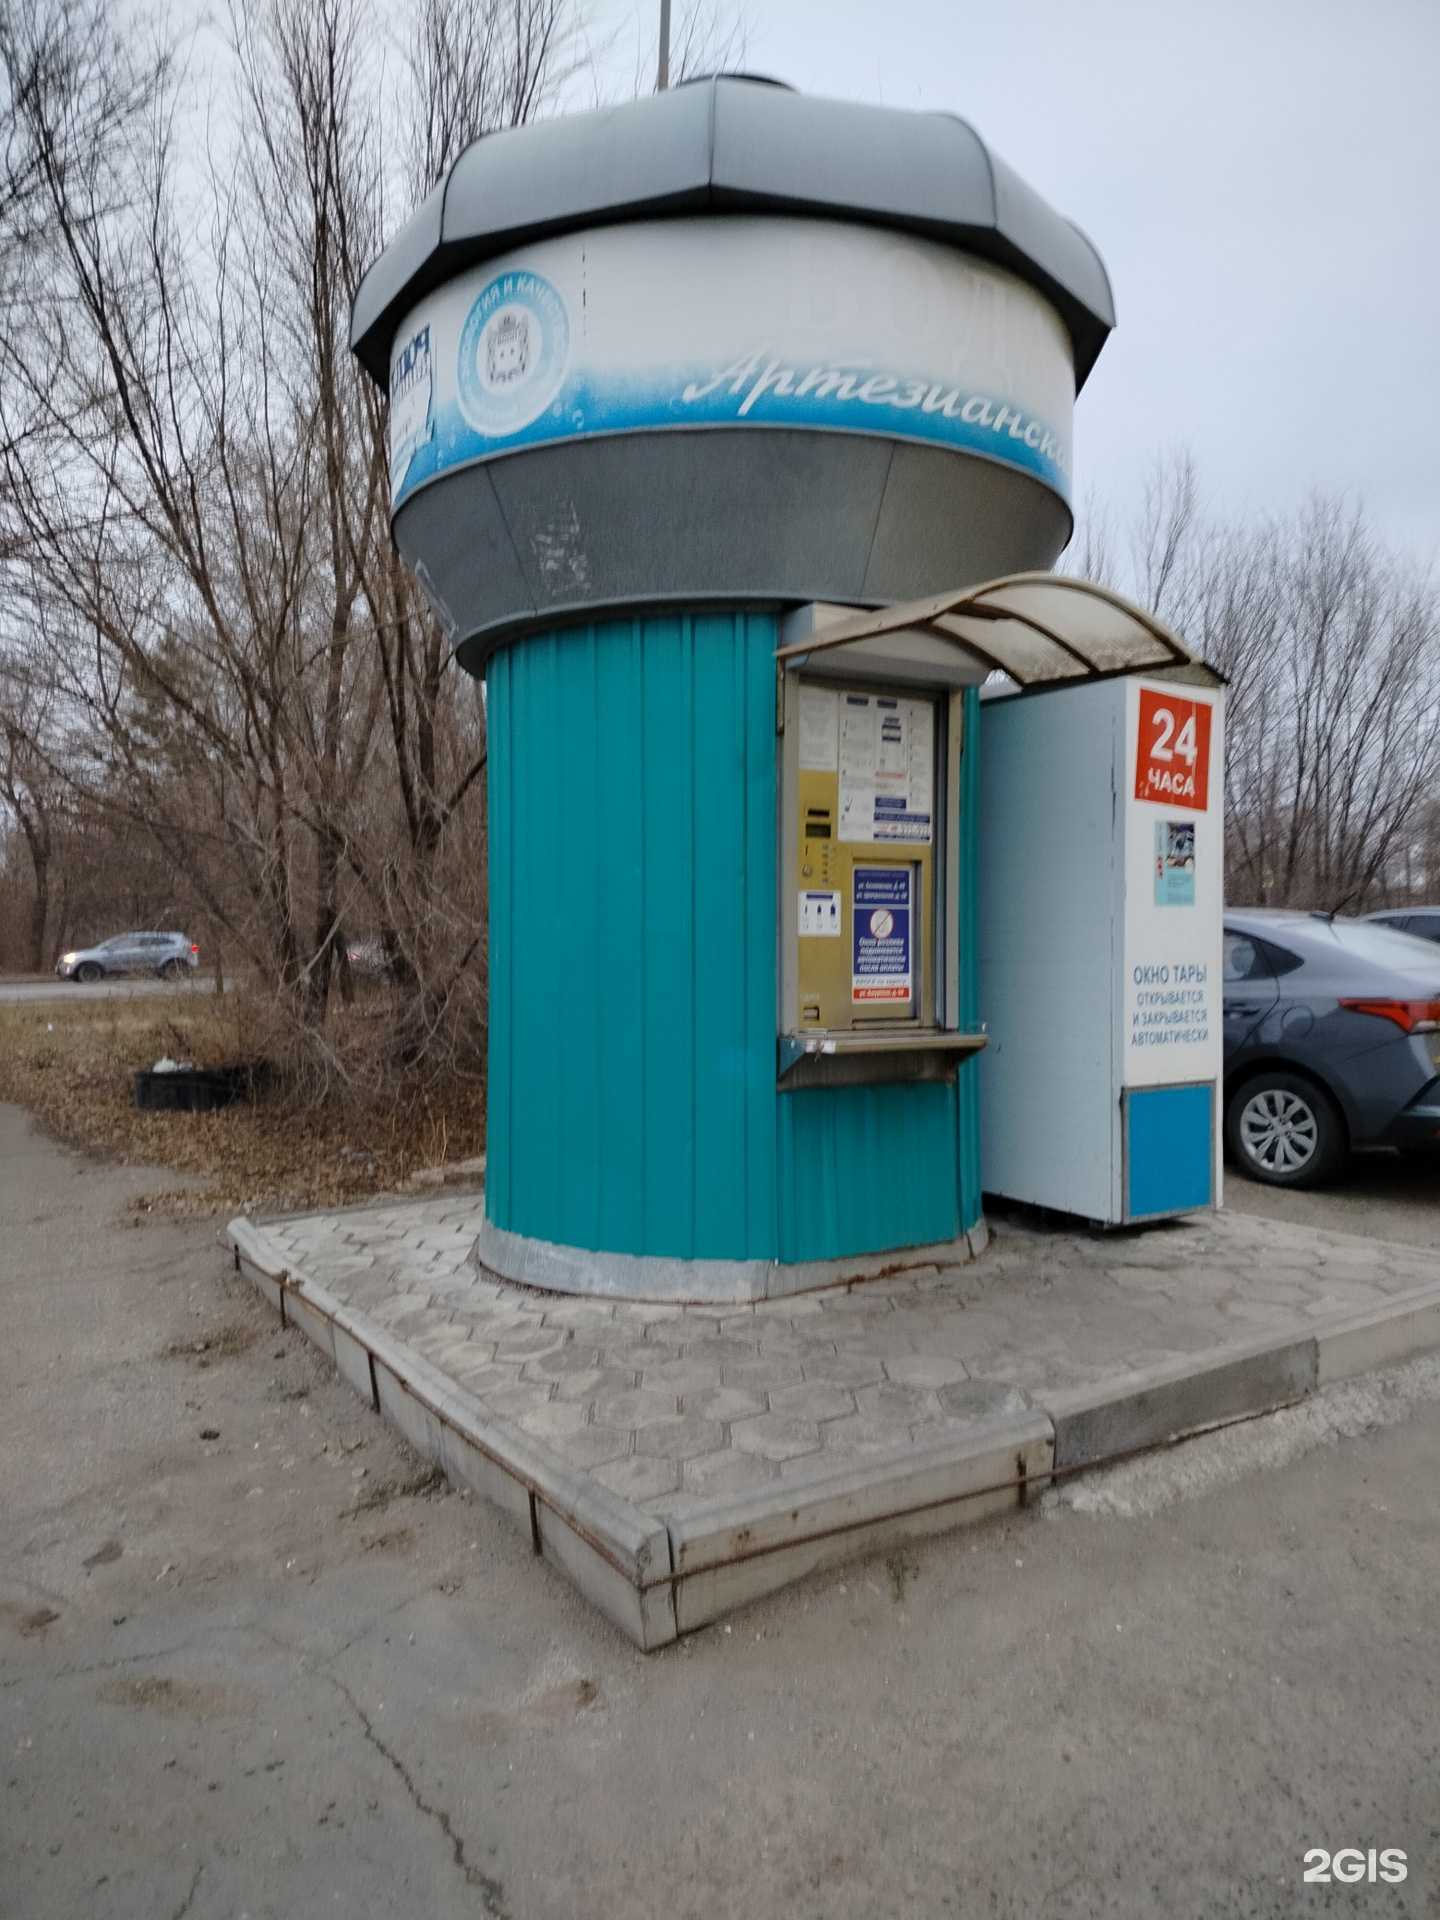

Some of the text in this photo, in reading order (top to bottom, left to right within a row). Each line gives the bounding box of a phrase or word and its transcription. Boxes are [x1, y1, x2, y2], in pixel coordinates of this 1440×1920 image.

[1150, 707, 1198, 767] 24
[1147, 767, 1196, 798] ЧАСА
[1133, 963, 1208, 985] ОКНО ТАРЫ
[1132, 1011, 1140, 1027] И
[1131, 1027, 1209, 1047] АВТОМАТИЧЕСКИ
